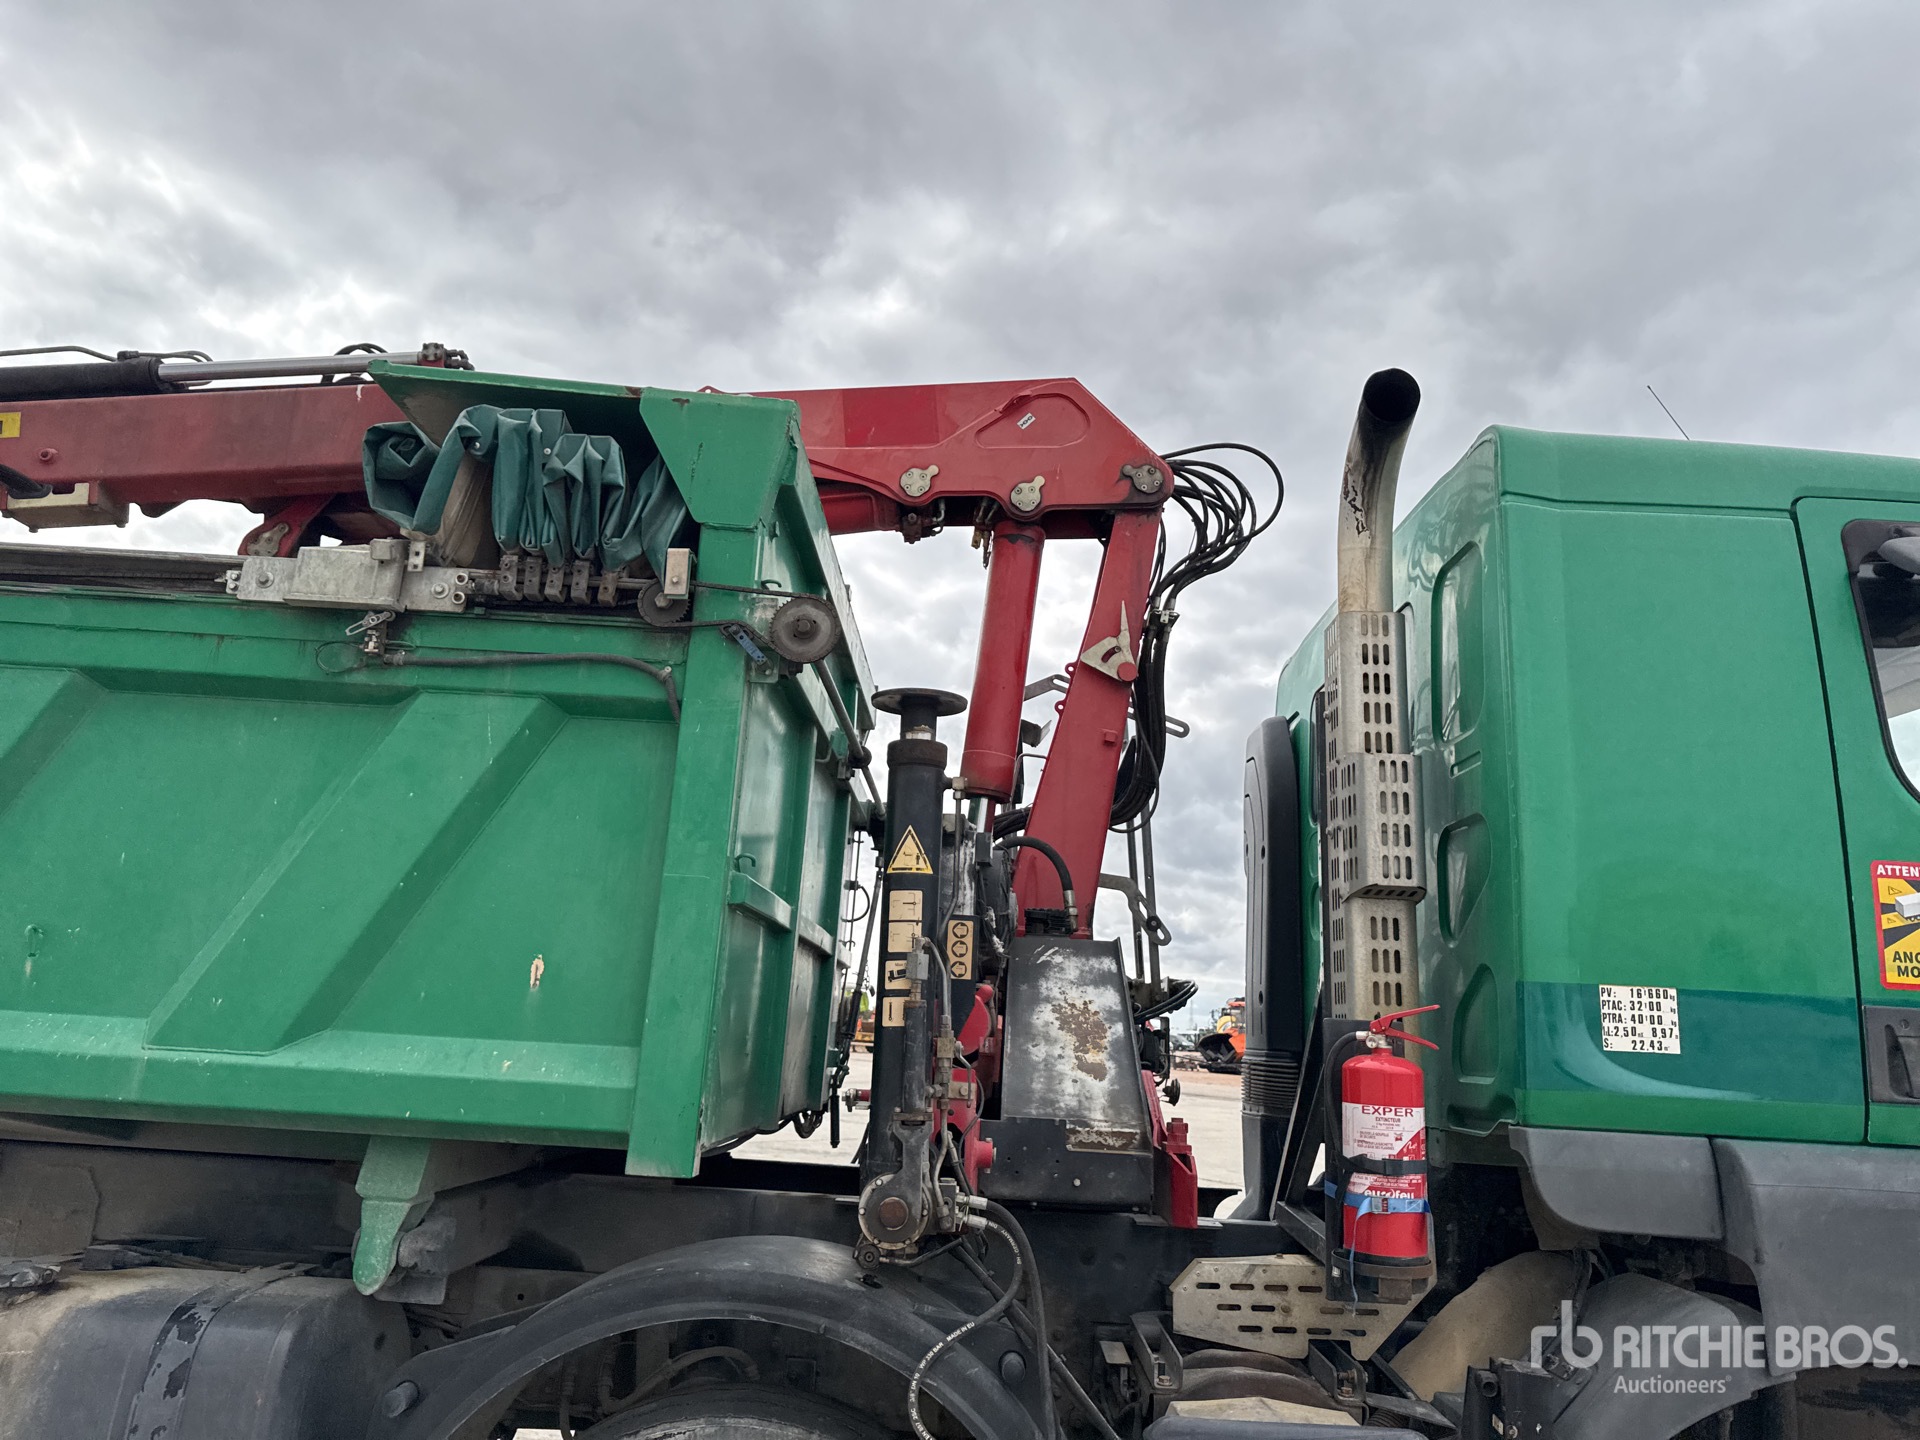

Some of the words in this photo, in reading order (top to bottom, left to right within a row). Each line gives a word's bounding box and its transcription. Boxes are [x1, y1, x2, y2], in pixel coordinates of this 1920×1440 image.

[1877, 864, 1920, 877] ATTEN
[1600, 987, 1616, 998] PV:
[1601, 1000, 1627, 1011] PTAC:
[1602, 1012, 1627, 1024] PTRA:
[1603, 1038, 1613, 1049] S:
[1361, 1105, 1414, 1117] EXPER
[932, 1342, 944, 1353] BAR
[946, 1328, 960, 1342] MADE
